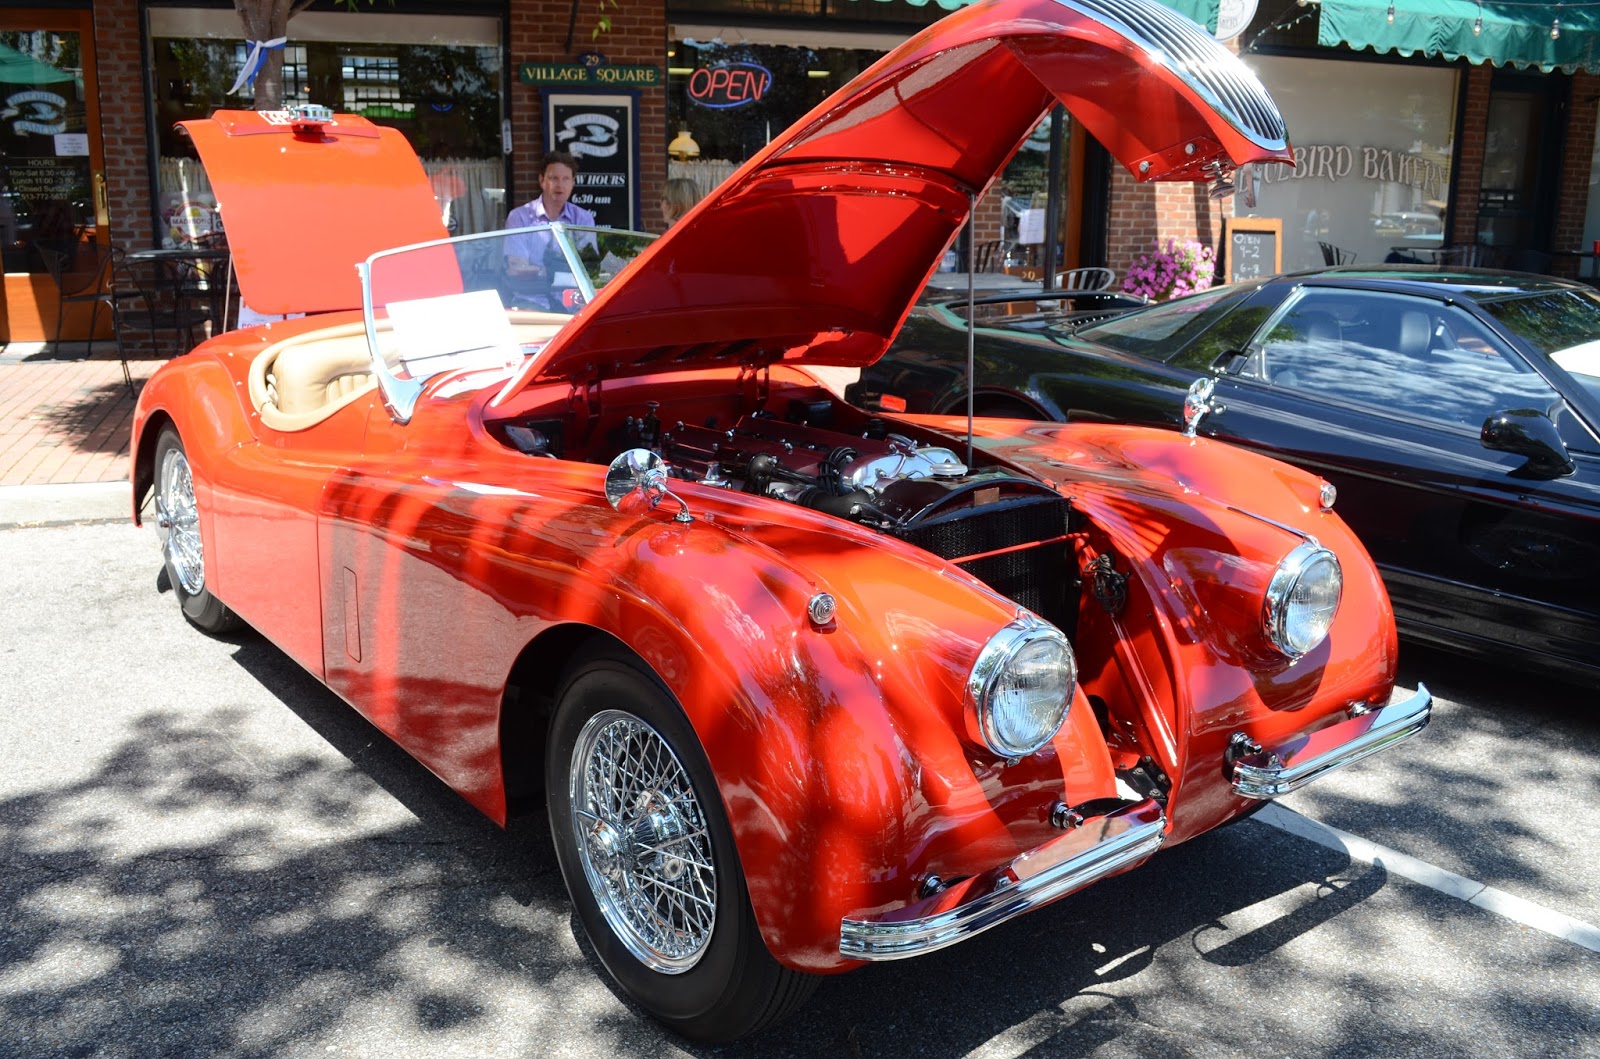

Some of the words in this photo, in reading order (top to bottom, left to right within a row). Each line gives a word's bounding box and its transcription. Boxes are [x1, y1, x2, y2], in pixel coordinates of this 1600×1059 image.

[585, 55, 599, 66] 29
[526, 68, 588, 80] VILLAGE
[596, 69, 655, 82] SQUARE
[690, 68, 765, 100] OPEN
[587, 174, 626, 185] HOURS
[1363, 147, 1447, 200] BAKERY
[571, 193, 594, 204] 6:30
[594, 196, 612, 204] am
